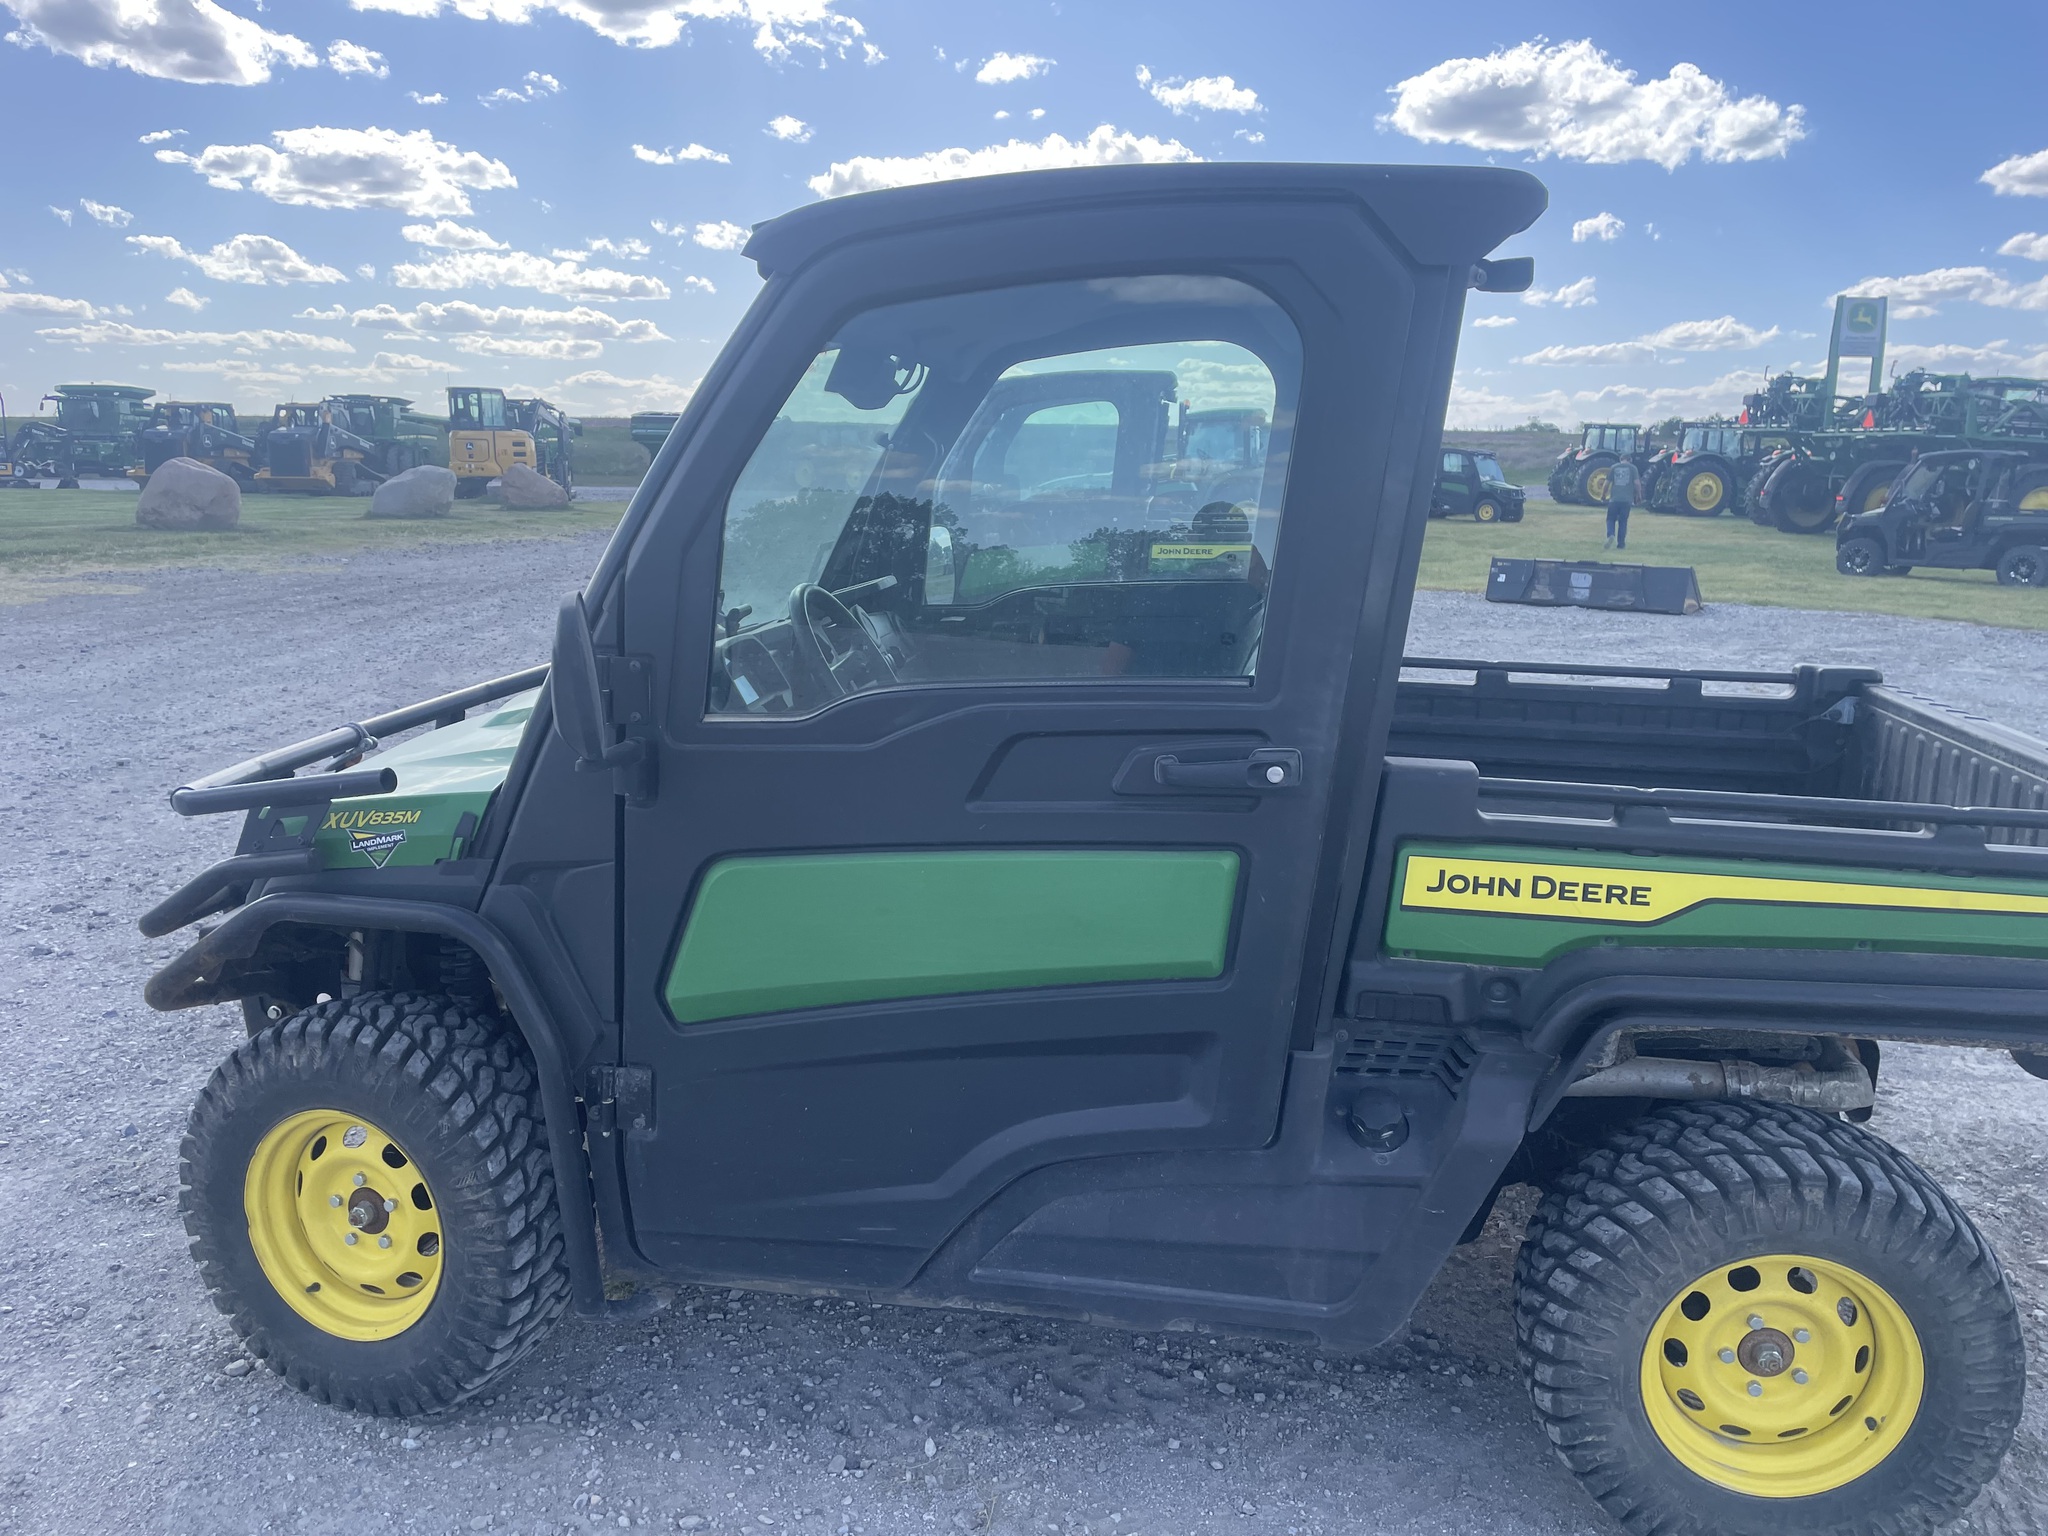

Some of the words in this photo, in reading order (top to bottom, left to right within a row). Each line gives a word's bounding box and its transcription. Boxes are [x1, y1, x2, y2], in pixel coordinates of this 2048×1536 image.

[1157, 547, 1182, 555] JOHN
[1183, 547, 1213, 555] DEERE
[321, 809, 421, 829] XUV835M
[352, 833, 404, 849] LANDMARK
[1426, 869, 1521, 898] JOHN
[1531, 875, 1652, 907] DEERE
